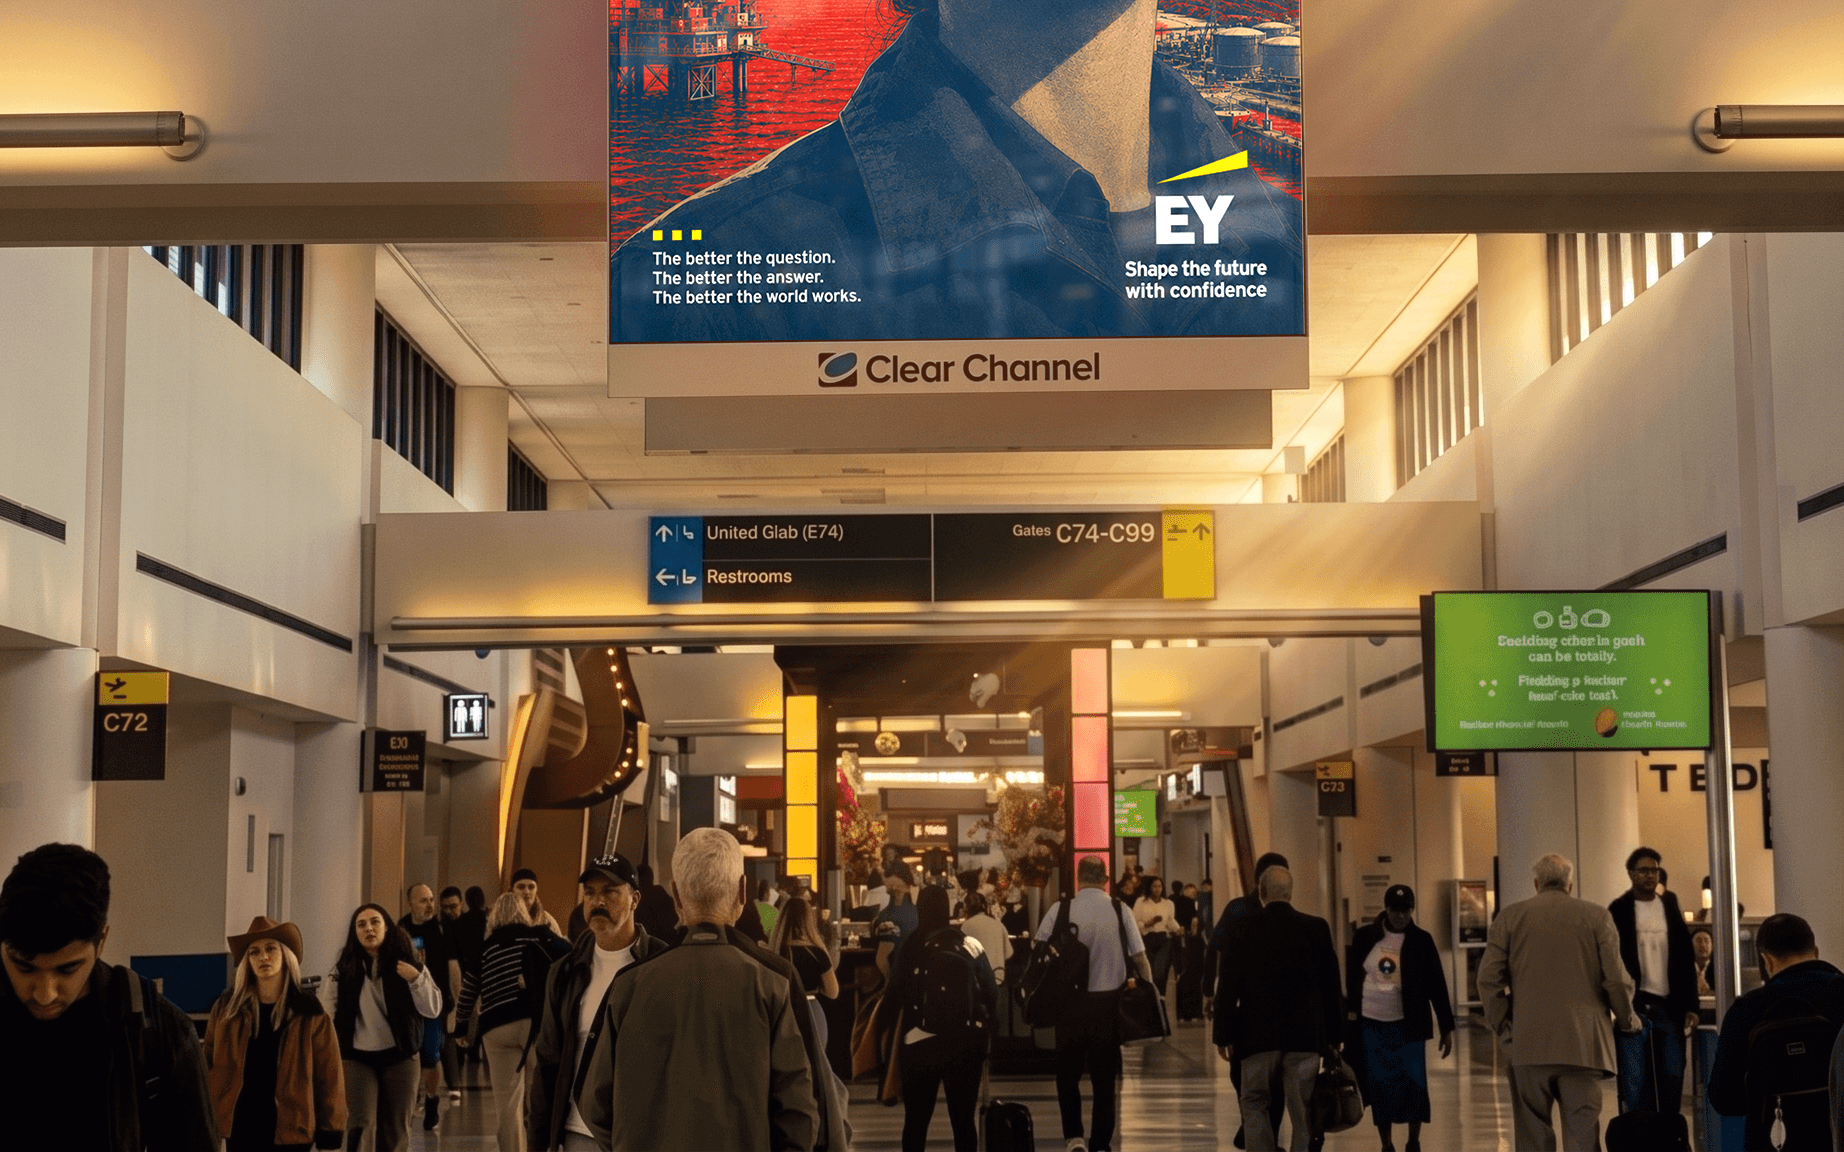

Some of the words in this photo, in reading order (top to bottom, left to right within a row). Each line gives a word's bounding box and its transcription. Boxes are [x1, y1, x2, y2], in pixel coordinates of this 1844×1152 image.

[1155, 194, 1234, 245] EY
[652, 251, 682, 266] The
[685, 251, 733, 266] better
[736, 250, 762, 265] the
[765, 250, 836, 268] question.
[652, 271, 682, 285] The
[685, 270, 733, 285] better
[736, 270, 763, 285] the
[765, 272, 824, 285] answer.
[1125, 260, 1179, 281] Shape
[1181, 259, 1211, 277] the
[1213, 259, 1268, 277] future
[652, 290, 682, 305] The
[686, 290, 734, 305] better
[736, 289, 763, 304] the
[766, 289, 808, 303] world
[811, 289, 862, 304] works.
[1125, 282, 1165, 299] with
[1169, 281, 1268, 299] confidence
[866, 355, 955, 383] Clear
[963, 352, 1100, 382] Channel
[706, 525, 759, 540] United
[762, 524, 799, 540] Glab
[802, 524, 844, 542] (E74)
[1012, 524, 1052, 537] Gates
[1056, 522, 1155, 544] C74-C99
[706, 569, 793, 584] Restrooms
[103, 712, 148, 732] C72
[1320, 781, 1346, 793] C73
